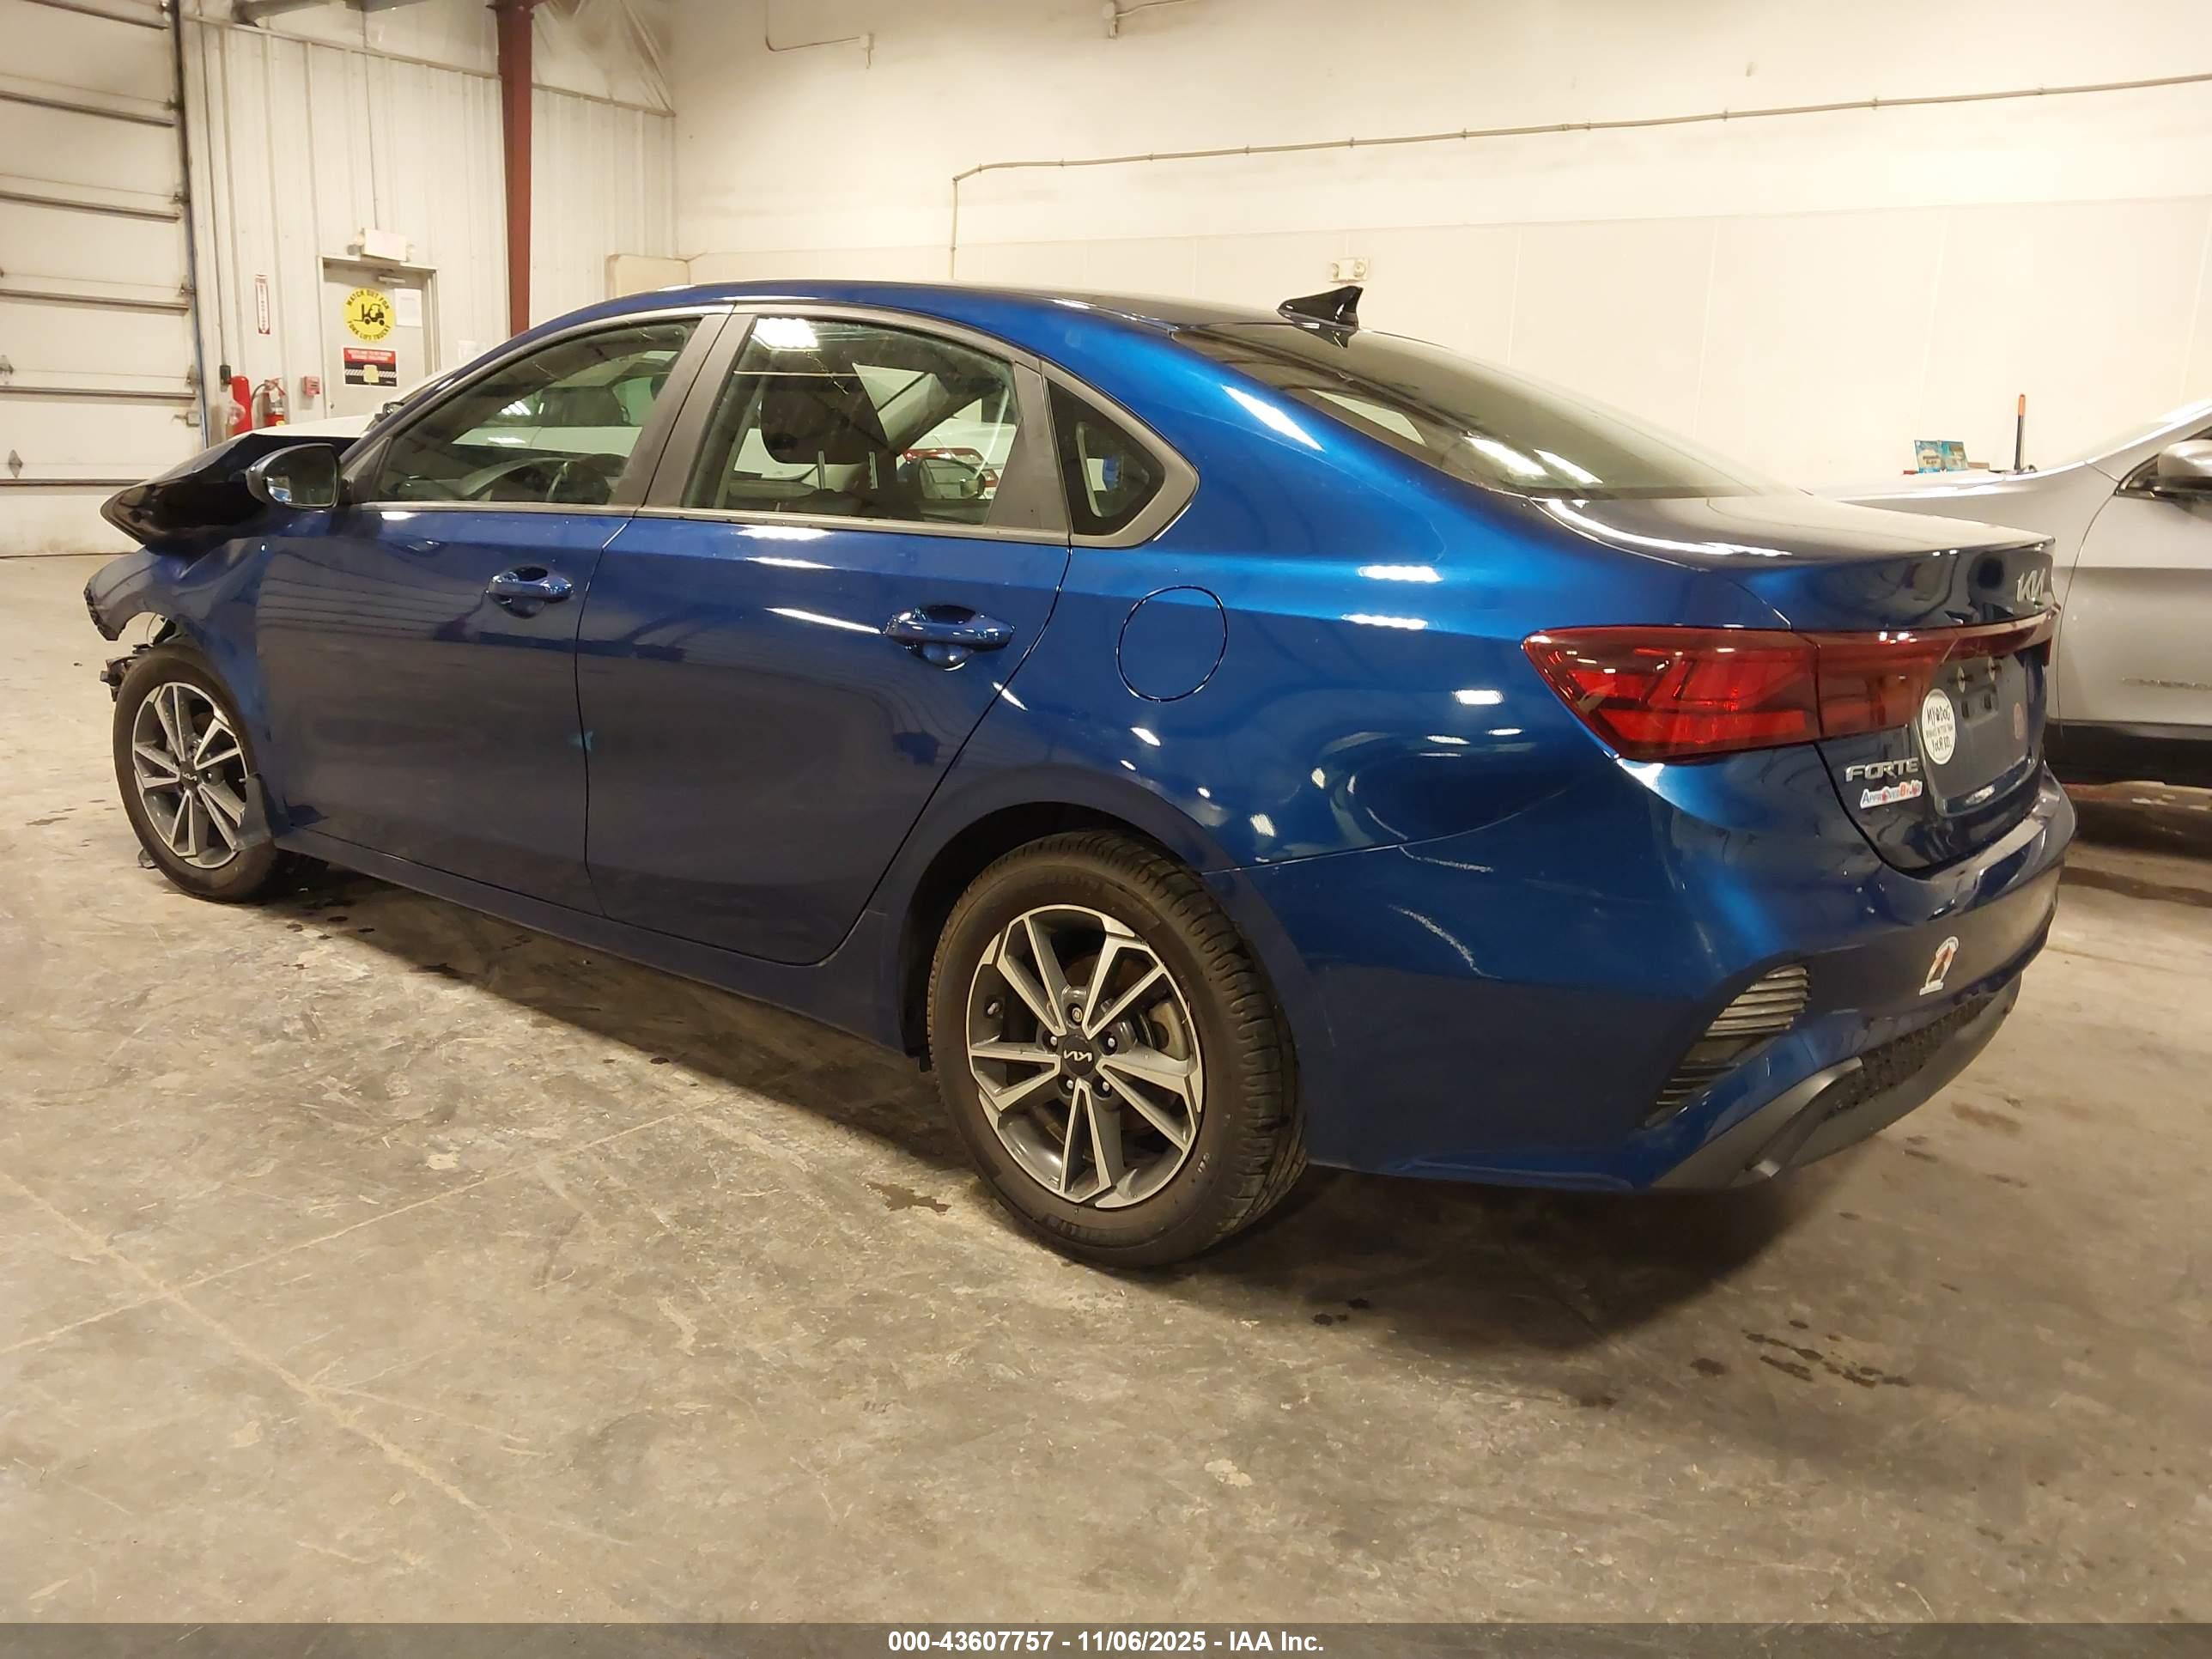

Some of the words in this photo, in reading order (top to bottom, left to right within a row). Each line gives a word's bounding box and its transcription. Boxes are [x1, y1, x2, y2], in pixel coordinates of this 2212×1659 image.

[346, 290, 365, 307] WATCH
[367, 289, 379, 298] OUT
[1845, 757, 1918, 782] FORTE
